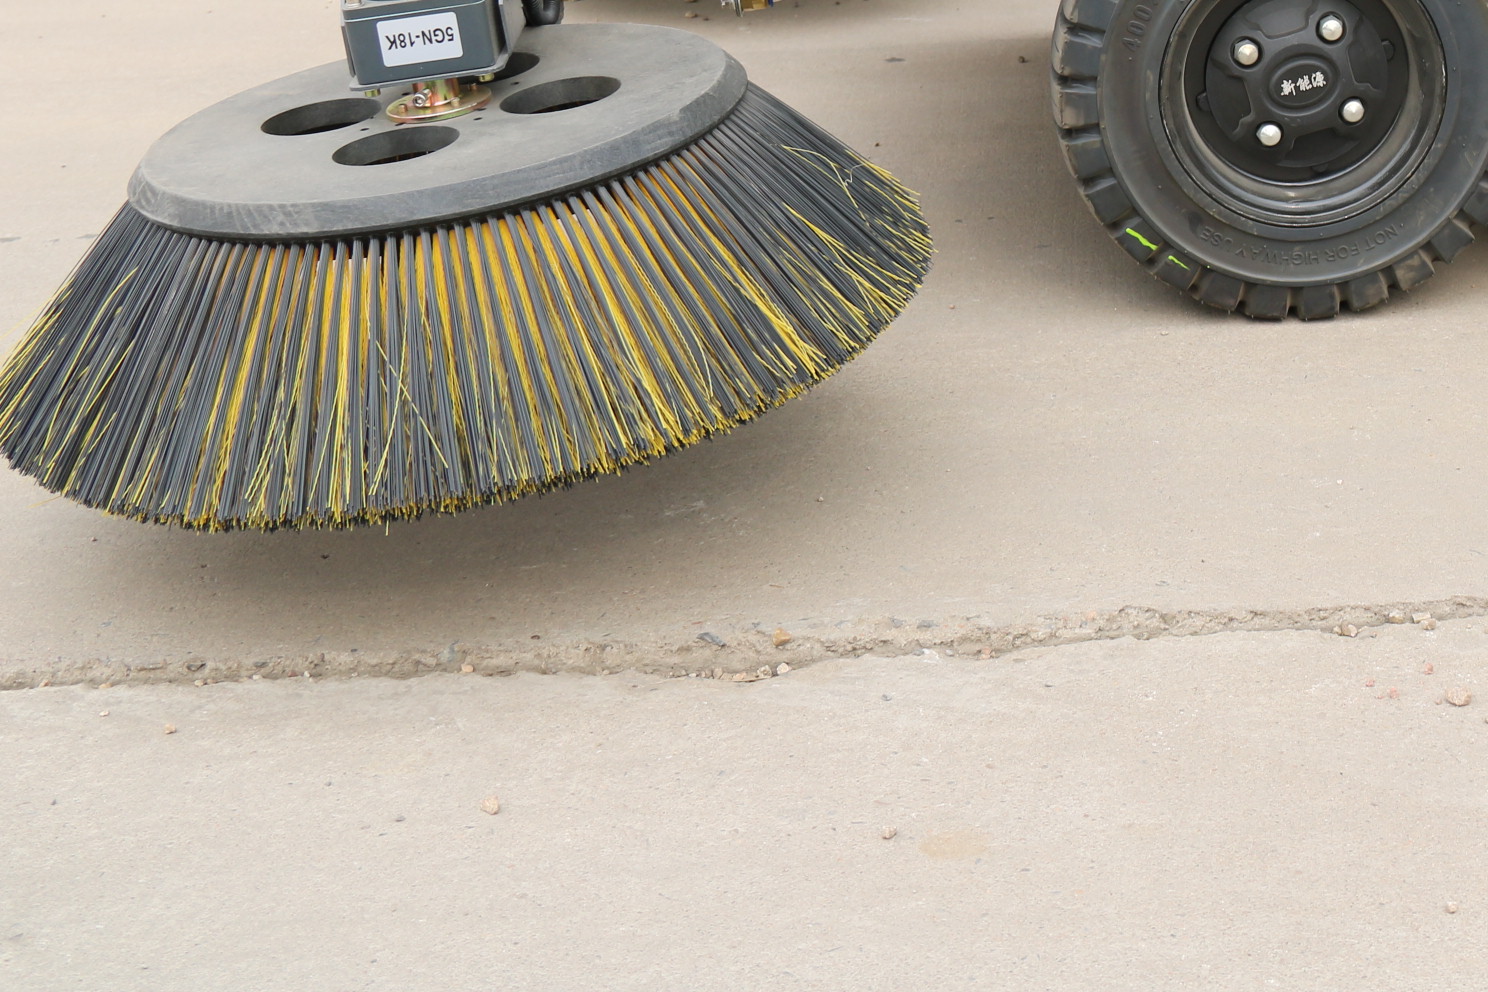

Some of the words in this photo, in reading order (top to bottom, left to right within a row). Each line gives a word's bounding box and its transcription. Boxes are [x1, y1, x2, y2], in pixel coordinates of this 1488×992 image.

[385, 26, 455, 51] 5GN-18K
[1280, 71, 1327, 97] 新能源
[1199, 225, 1234, 249] USE
[1363, 223, 1400, 252] NOT
[1234, 243, 1320, 267] HIGHWAY
[1323, 240, 1361, 262] FOR
